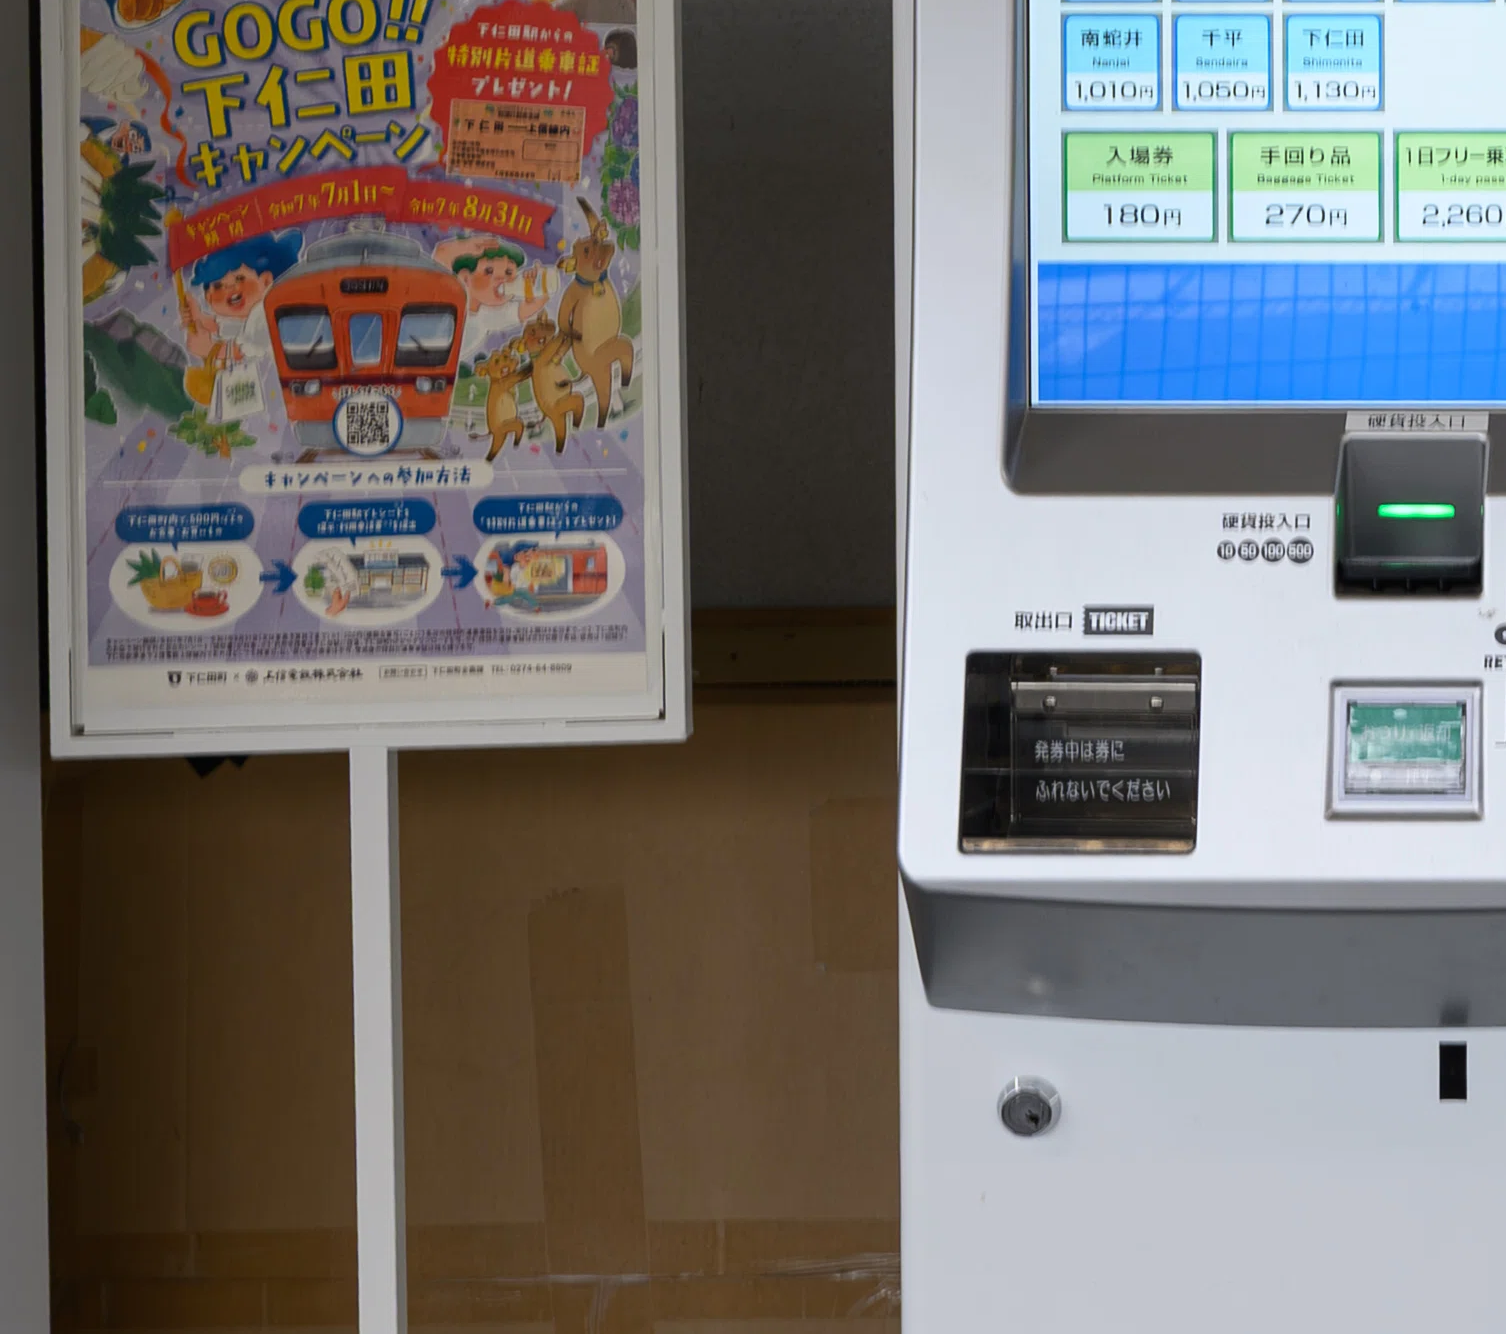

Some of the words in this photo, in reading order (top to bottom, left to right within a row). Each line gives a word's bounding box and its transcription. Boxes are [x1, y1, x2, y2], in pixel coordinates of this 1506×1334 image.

[1081, 28, 1143, 49] 南蛇井
[1202, 28, 1243, 49] 千平
[1302, 28, 1364, 49] 下仁田
[180, 49, 418, 139] 下仁田
[1074, 80, 1154, 103] 1,010円
[1183, 80, 1266, 103] 1,050円
[1294, 80, 1376, 103] 1,130円
[189, 119, 431, 189] キャンペーン
[1106, 146, 1174, 167] 入場券
[1260, 146, 1351, 167] 手回り品
[1103, 203, 1182, 228] 180円
[1265, 203, 1347, 228] 270円
[1367, 413, 1466, 430] 硬貨投入口
[1221, 512, 1312, 531] 硬貨投入口
[1219, 542, 1234, 560] 10
[1263, 542, 1285, 560] 100
[1014, 610, 1073, 631] 取出口
[1088, 611, 1149, 632] TICKET
[1034, 739, 1125, 764] 発券中は券に
[1035, 780, 1171, 802] ふれないでください
